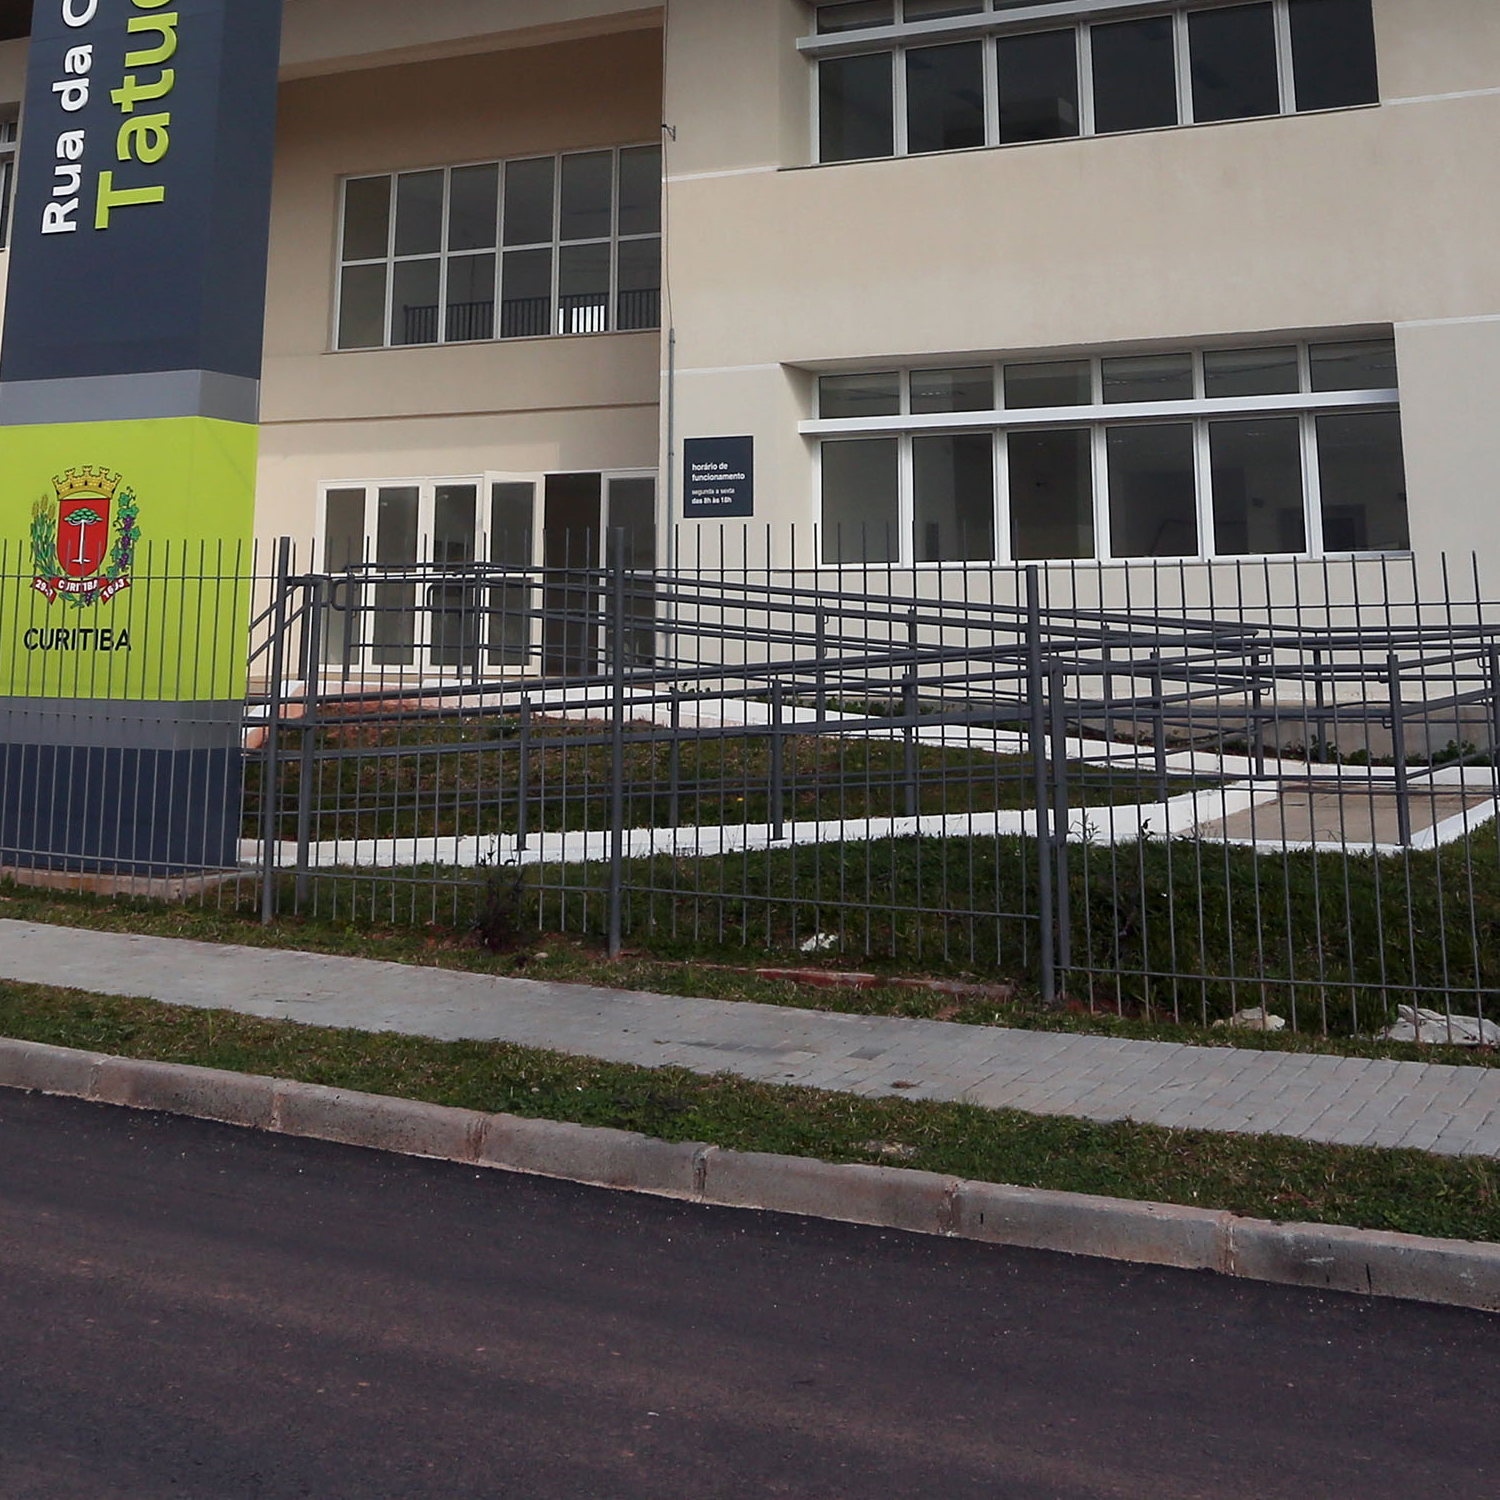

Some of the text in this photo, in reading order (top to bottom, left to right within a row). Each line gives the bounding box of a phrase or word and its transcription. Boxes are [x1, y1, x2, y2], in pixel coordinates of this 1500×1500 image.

[52, 44, 93, 112] da
[41, 130, 85, 234] Rua
[691, 473, 746, 481] funcionamento
[719, 462, 729, 470] de
[24, 627, 132, 651] CURITIBA
